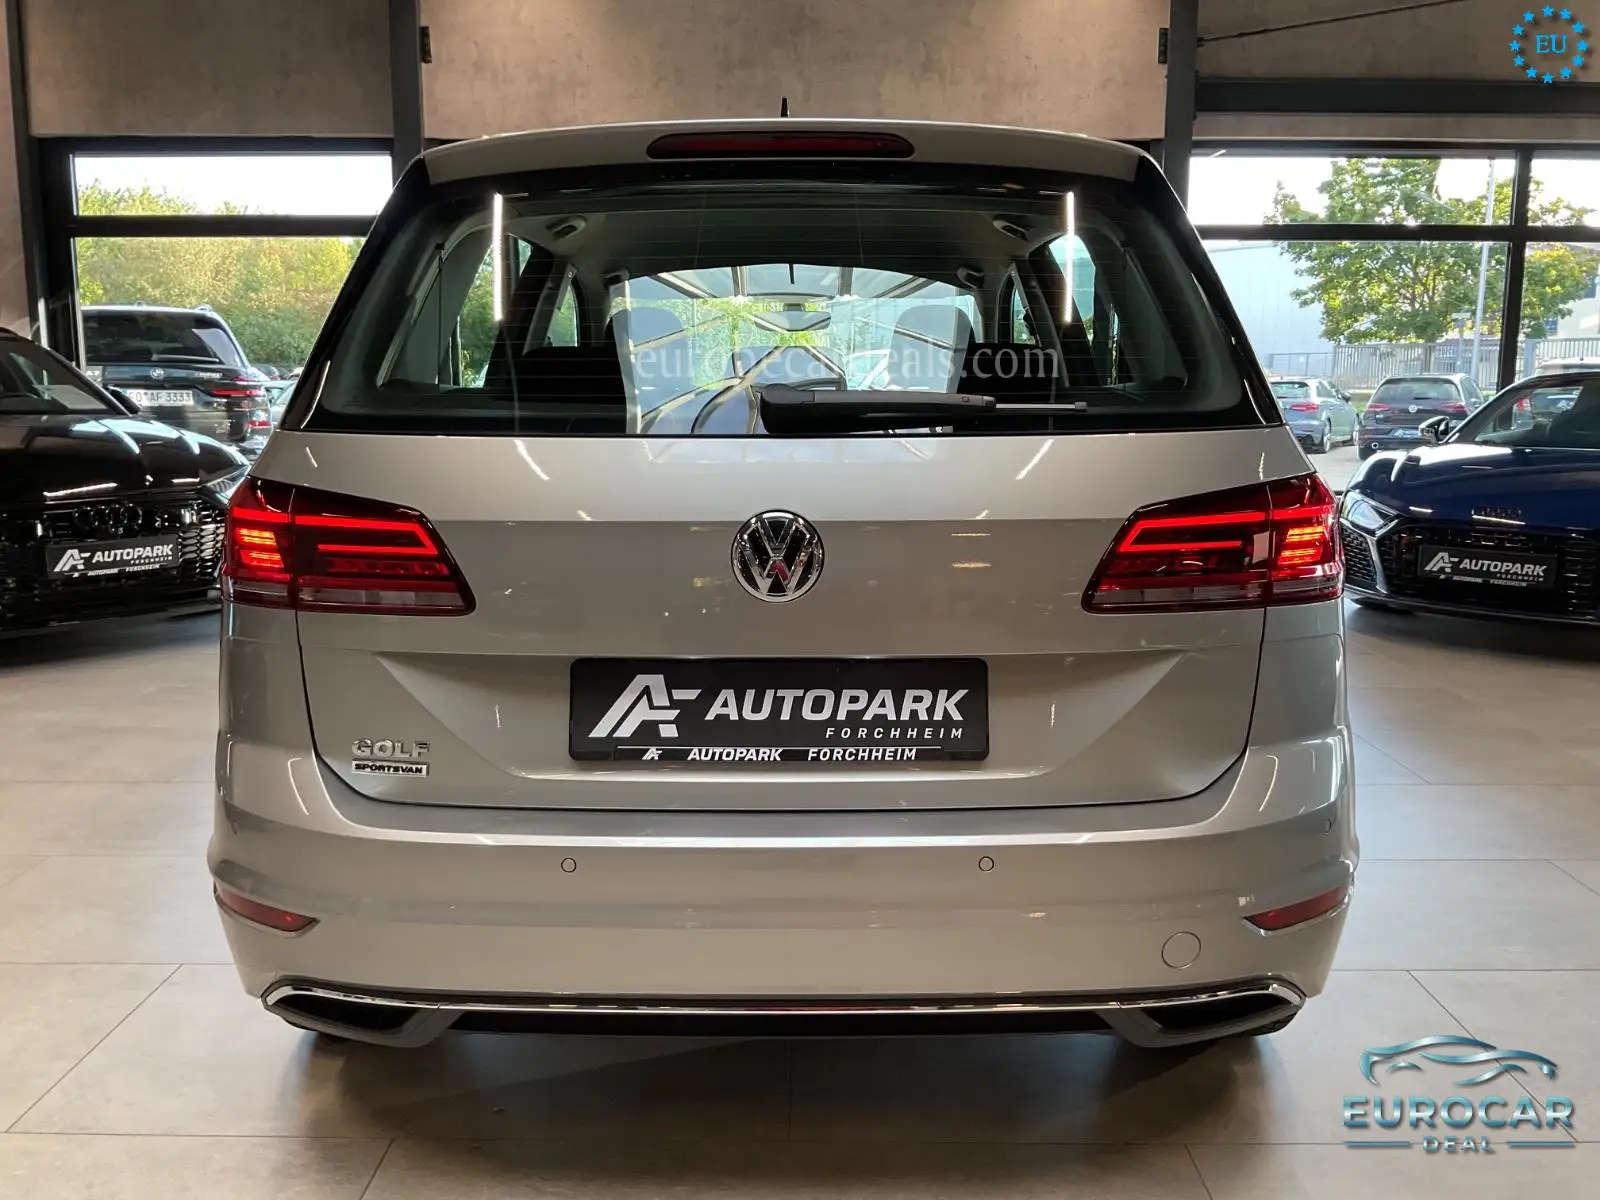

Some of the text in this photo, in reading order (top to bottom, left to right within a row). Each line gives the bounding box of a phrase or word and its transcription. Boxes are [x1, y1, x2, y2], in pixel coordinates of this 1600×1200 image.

[92, 544, 173, 563] AUTOPARK
[1459, 558, 1548, 576] AUTOPARK
[704, 688, 969, 721] AUTOPARK
[825, 727, 963, 739] FORCHHEIM
[351, 739, 430, 758] GOLF
[687, 748, 783, 761] AUTOPARK
[807, 748, 917, 761] FORCHHEIM
[354, 763, 423, 774] SPORTSVAN
